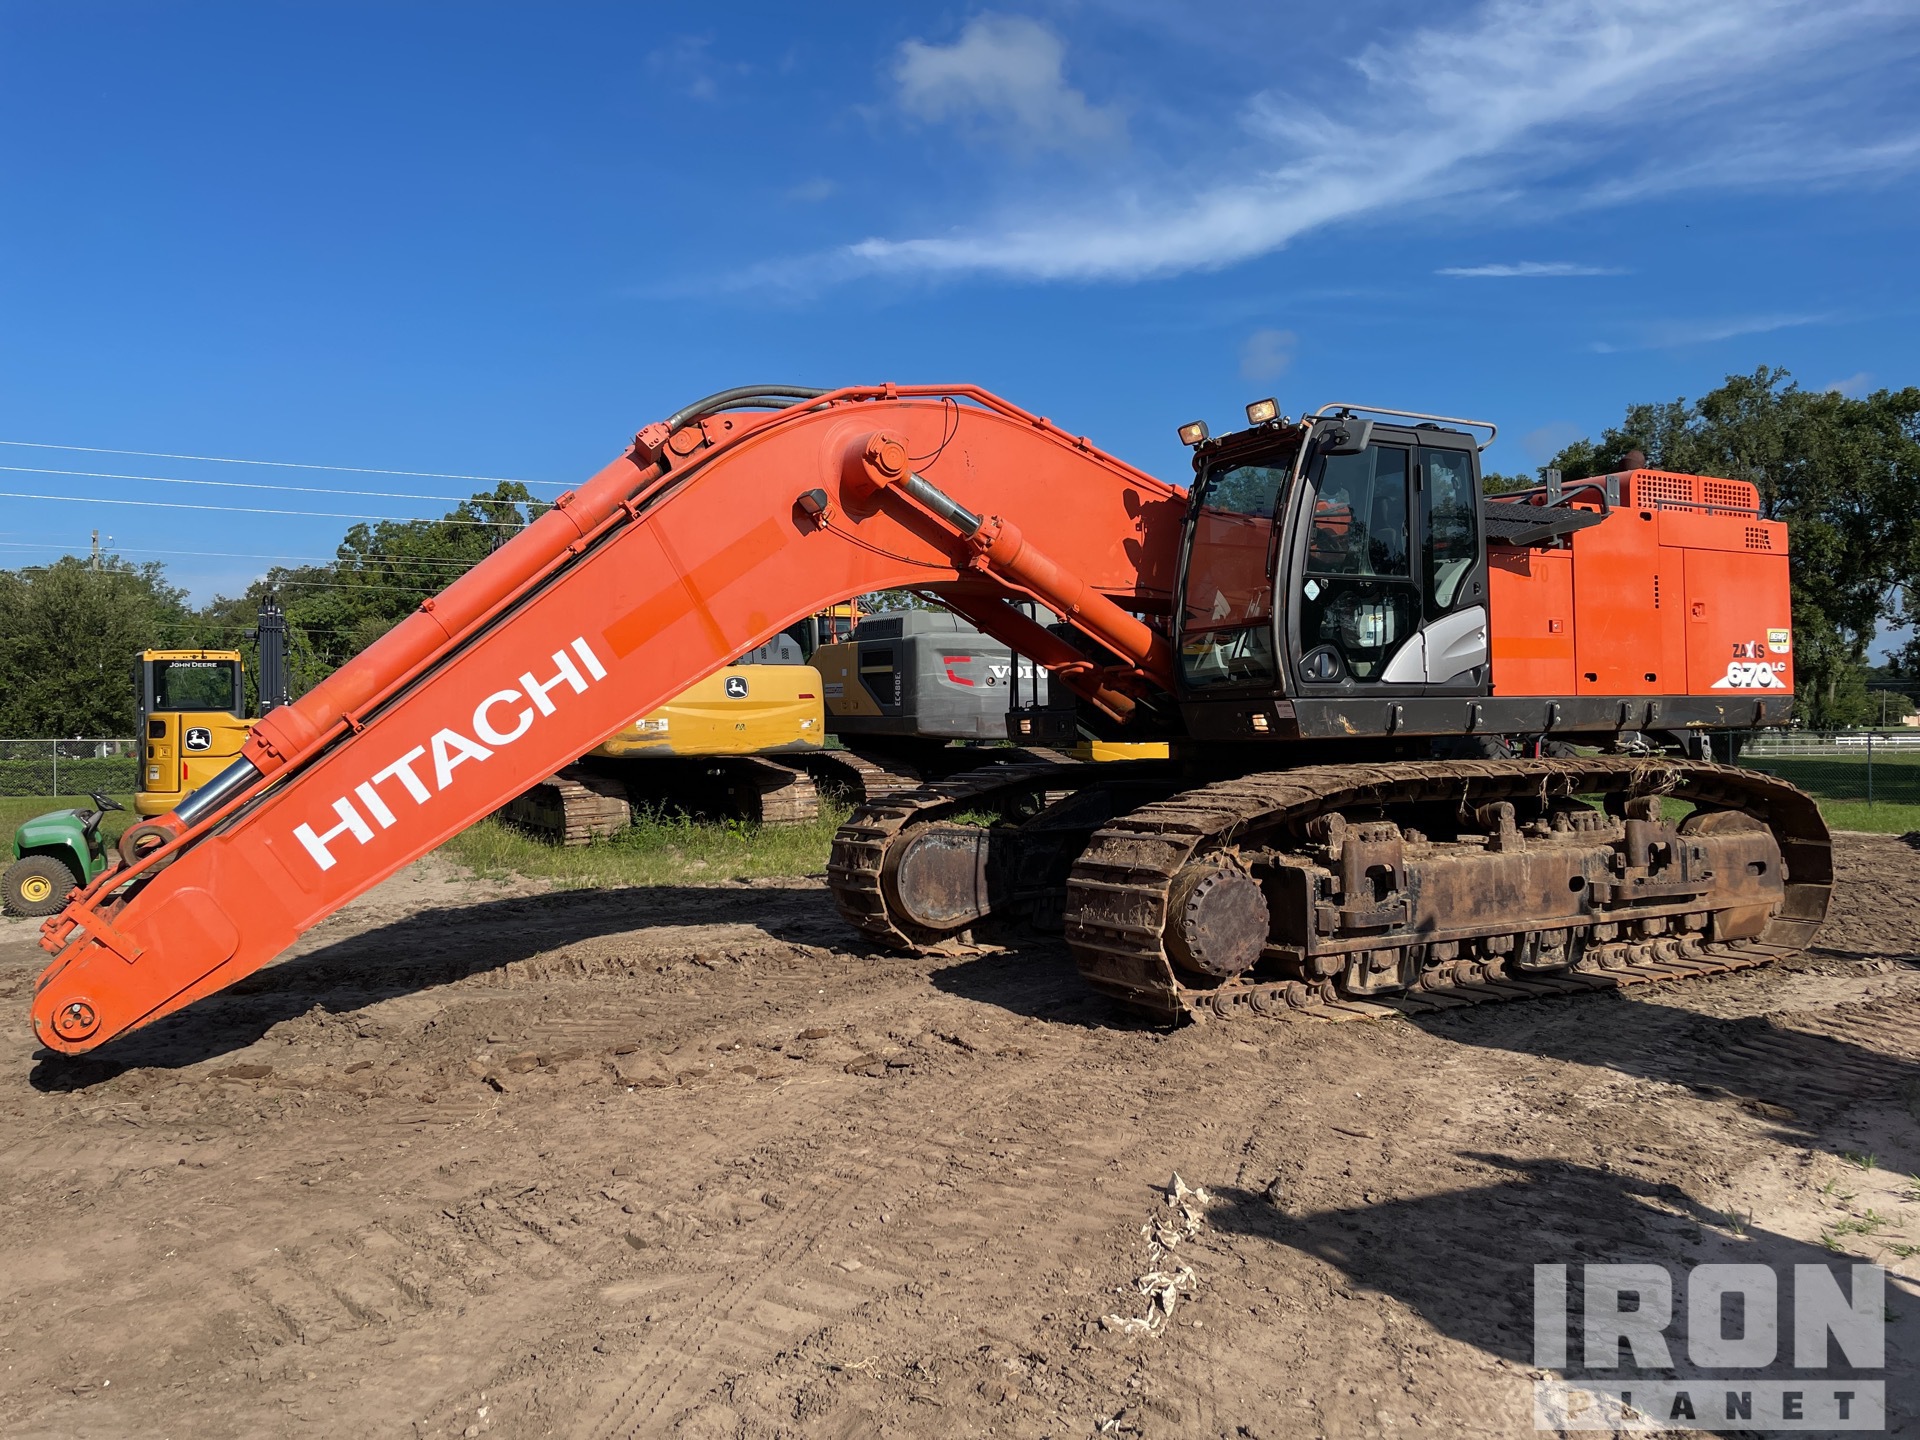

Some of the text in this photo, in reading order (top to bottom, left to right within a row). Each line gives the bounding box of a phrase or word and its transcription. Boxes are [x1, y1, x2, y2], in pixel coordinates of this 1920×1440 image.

[1732, 640, 1765, 659] ZAXIS
[988, 665, 1049, 679] VOLV
[292, 636, 608, 872] HITACHI
